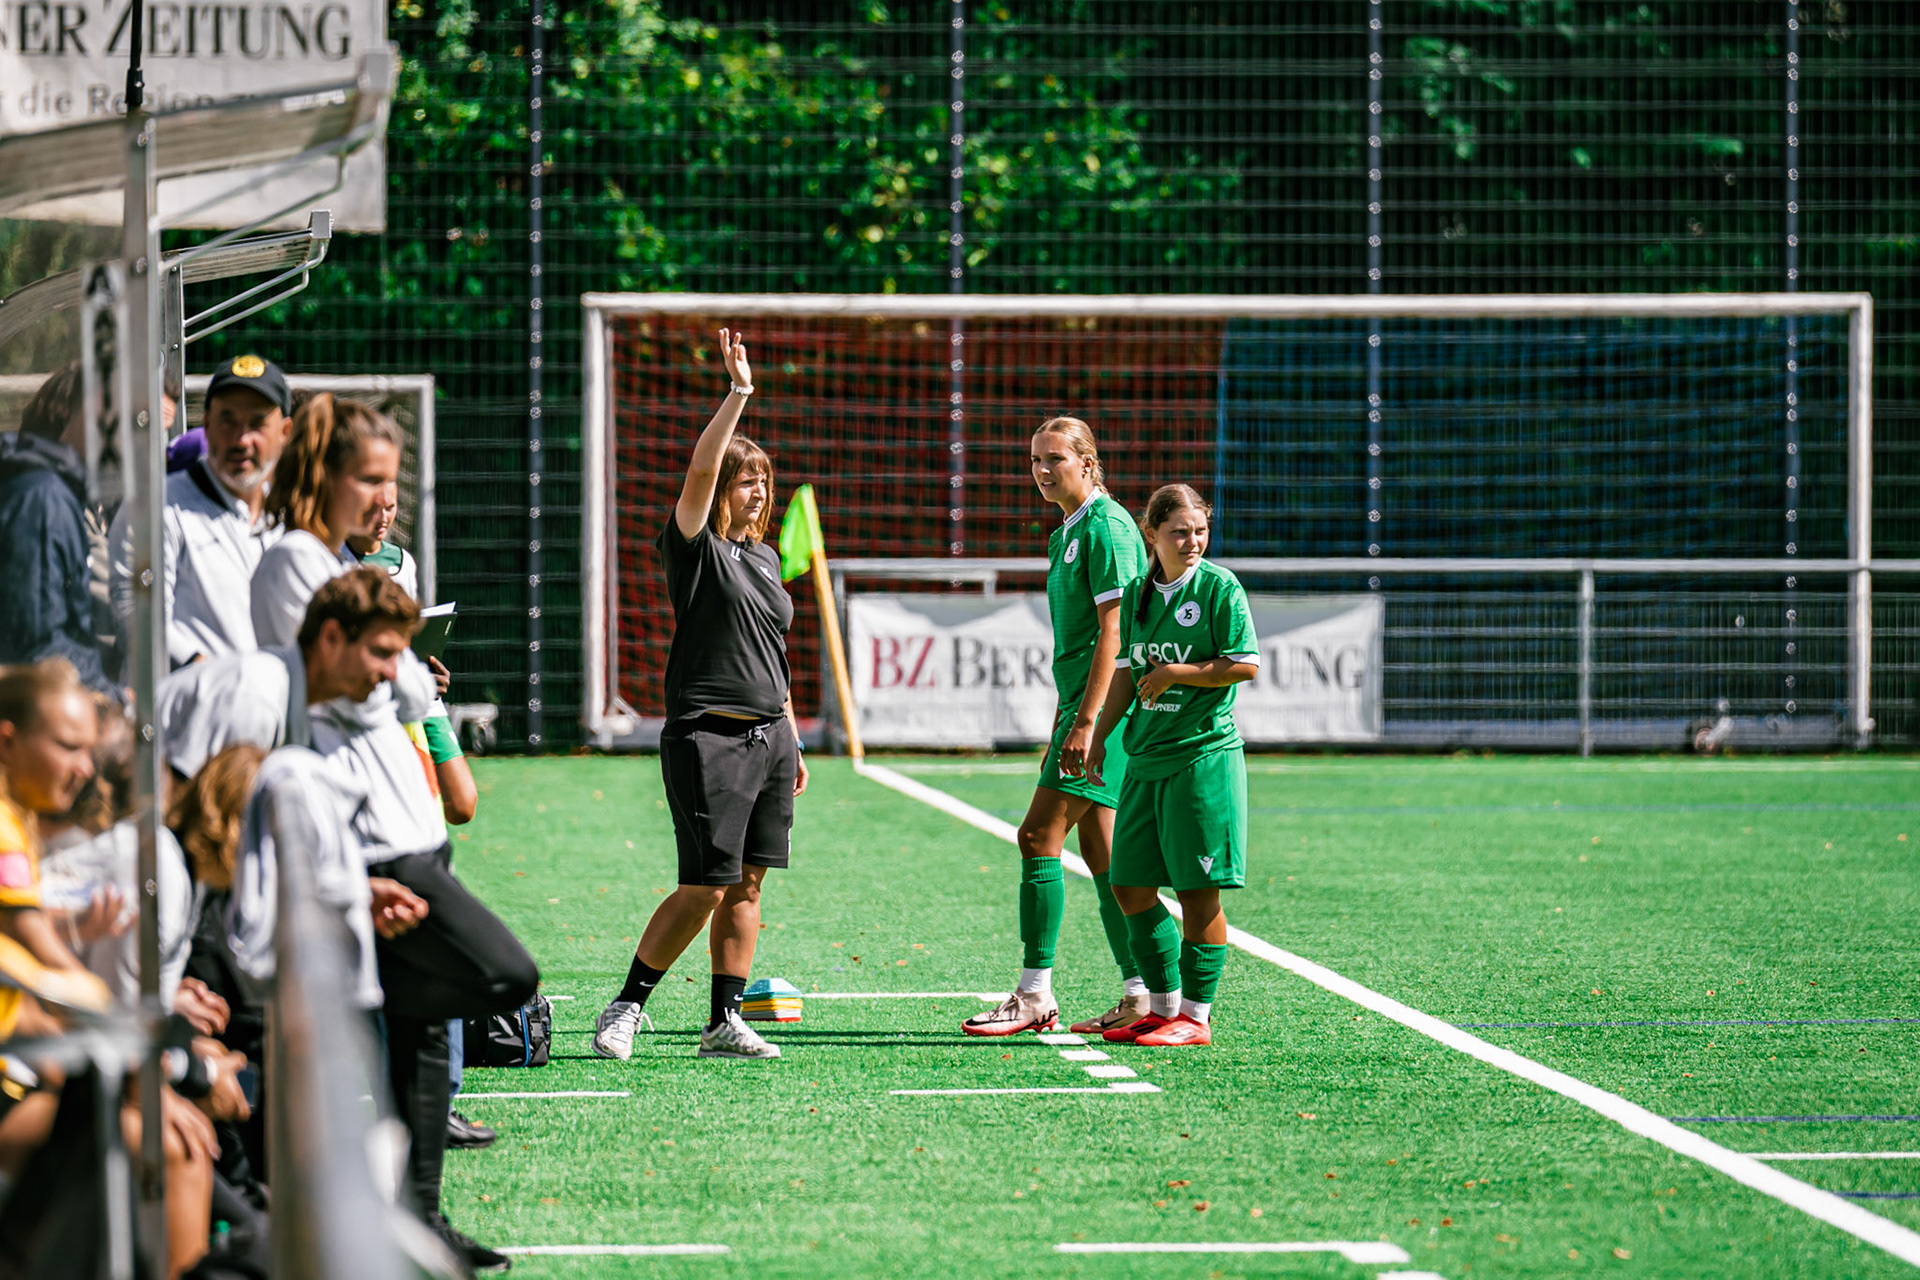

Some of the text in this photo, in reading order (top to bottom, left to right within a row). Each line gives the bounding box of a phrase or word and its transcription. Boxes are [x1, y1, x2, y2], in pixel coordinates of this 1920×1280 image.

[0, 0, 351, 60] ER ZEITUNG
[18, 80, 72, 118] die
[871, 635, 1364, 691] BZ BER UNG
[1147, 642, 1193, 664] BCV
